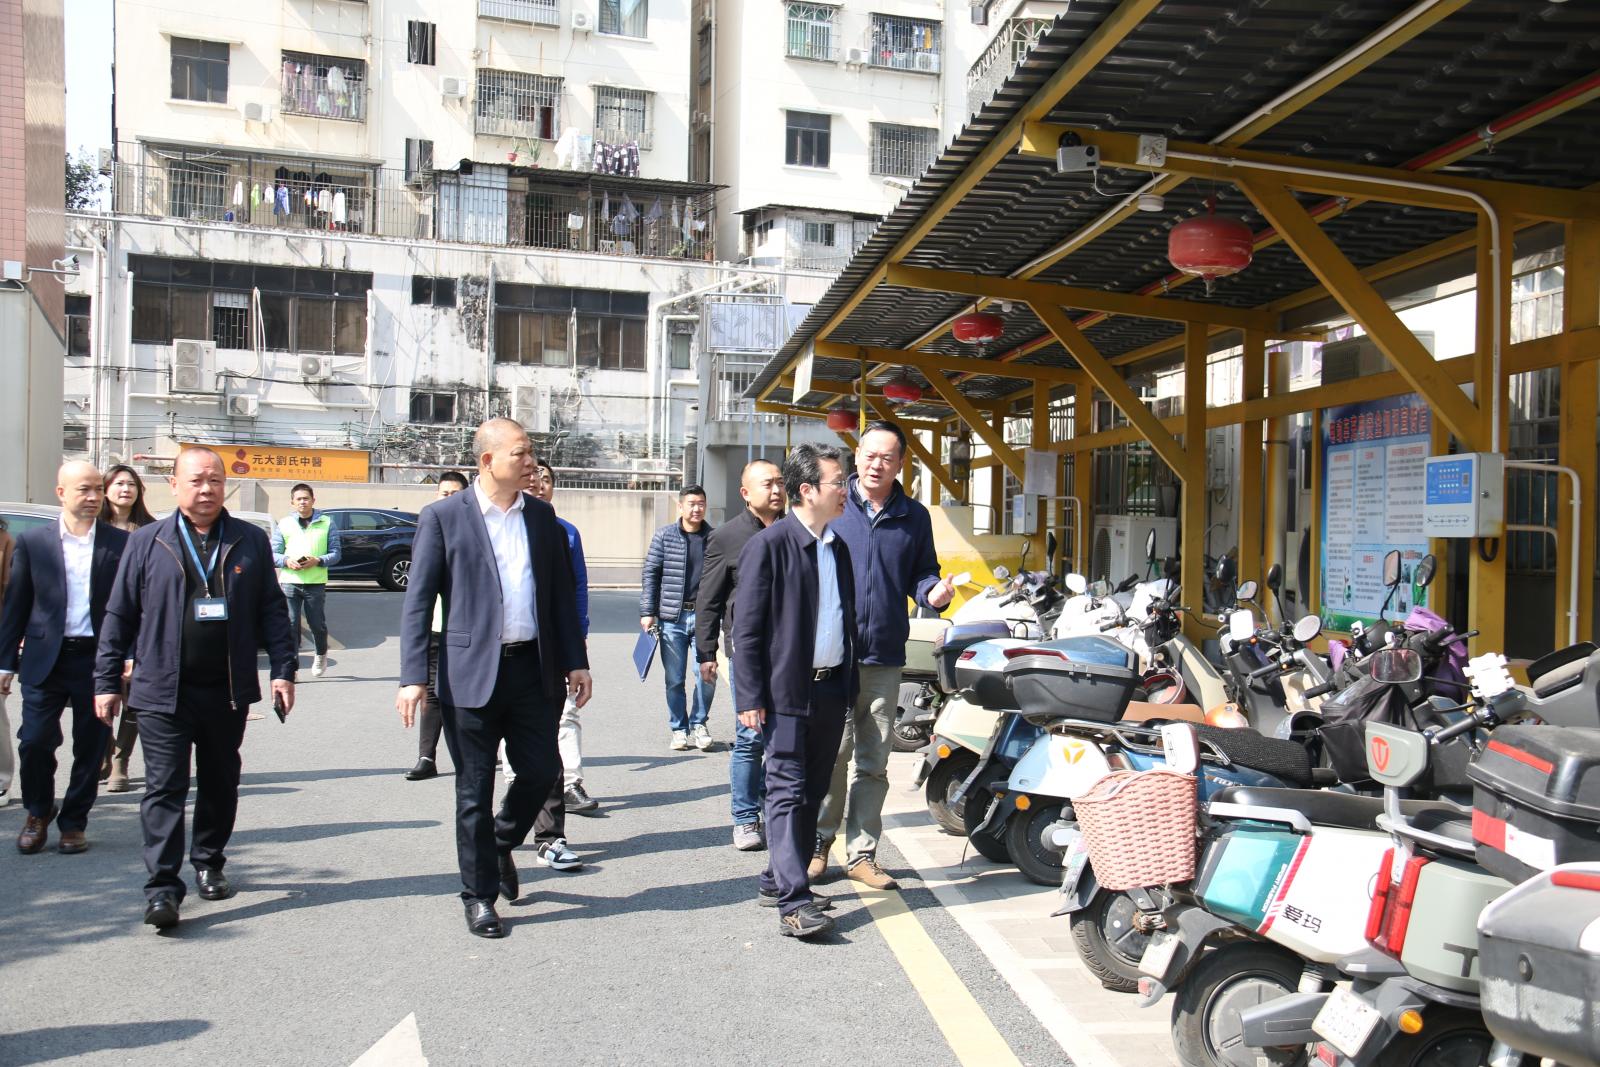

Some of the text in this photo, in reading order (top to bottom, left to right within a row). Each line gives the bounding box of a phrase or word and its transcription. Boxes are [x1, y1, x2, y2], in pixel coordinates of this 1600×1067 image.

[252, 454, 322, 467] 元大劉氏中醫
[1282, 904, 1322, 933] 爱玛
